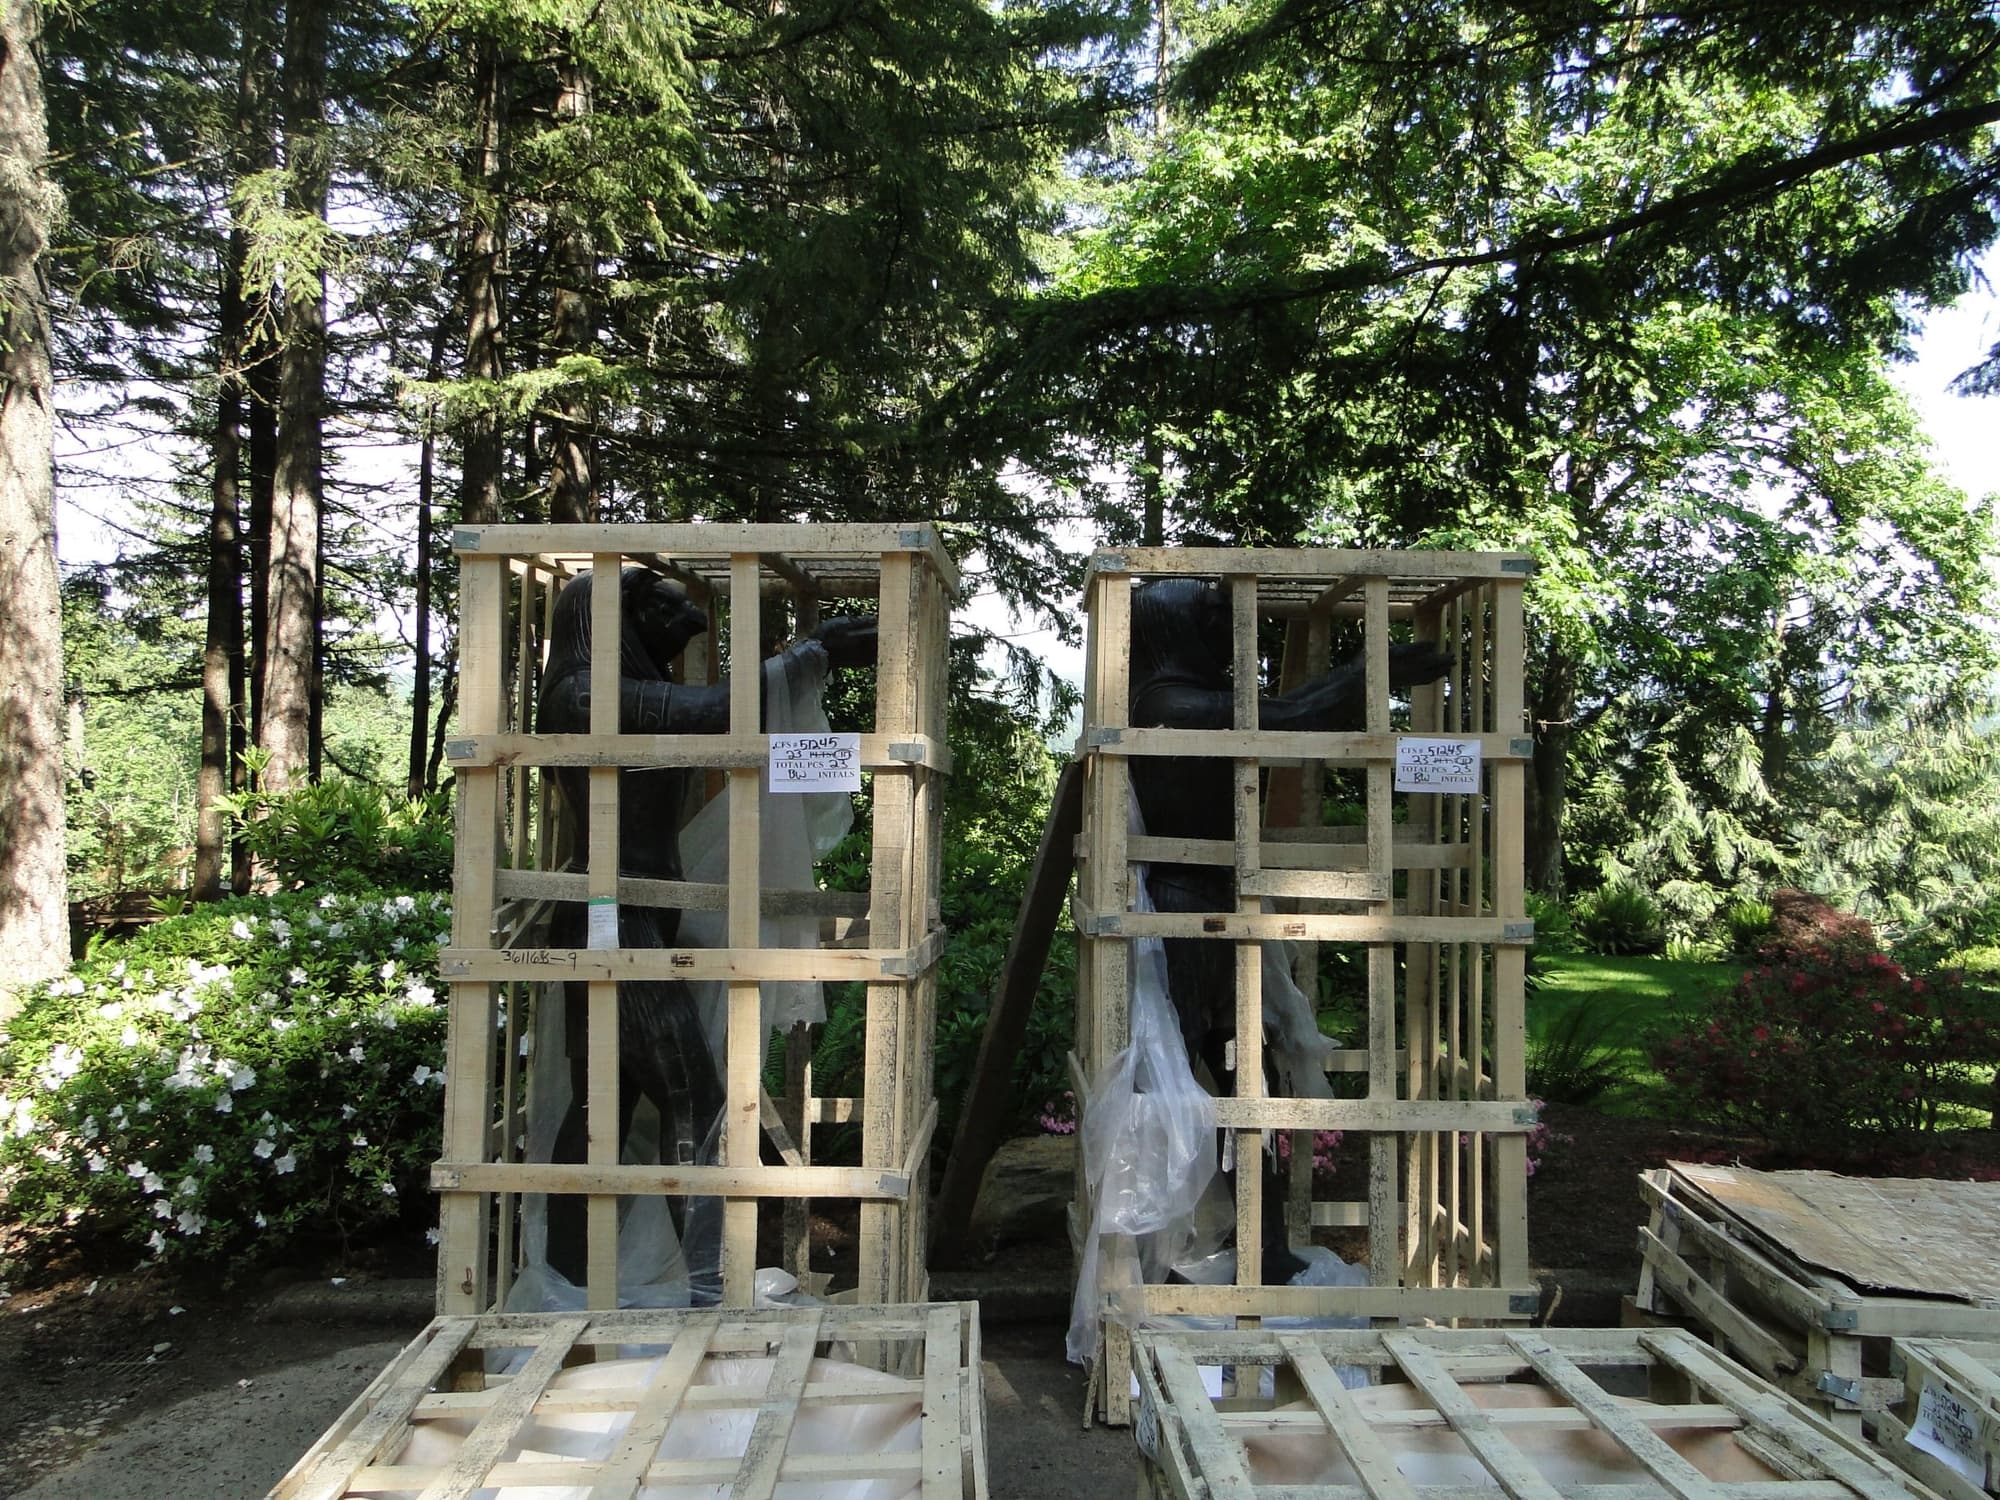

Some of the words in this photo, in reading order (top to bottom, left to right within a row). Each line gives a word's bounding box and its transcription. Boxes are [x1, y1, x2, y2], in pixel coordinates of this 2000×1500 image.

[774, 741, 791, 749] CFS
[800, 736, 840, 750] 51245
[786, 749, 802, 760] 23
[1428, 744, 1465, 757] 51245
[776, 761, 805, 769] TOTAL
[808, 761, 824, 769] PCS
[829, 760, 848, 769] 23
[1412, 754, 1429, 765] 23
